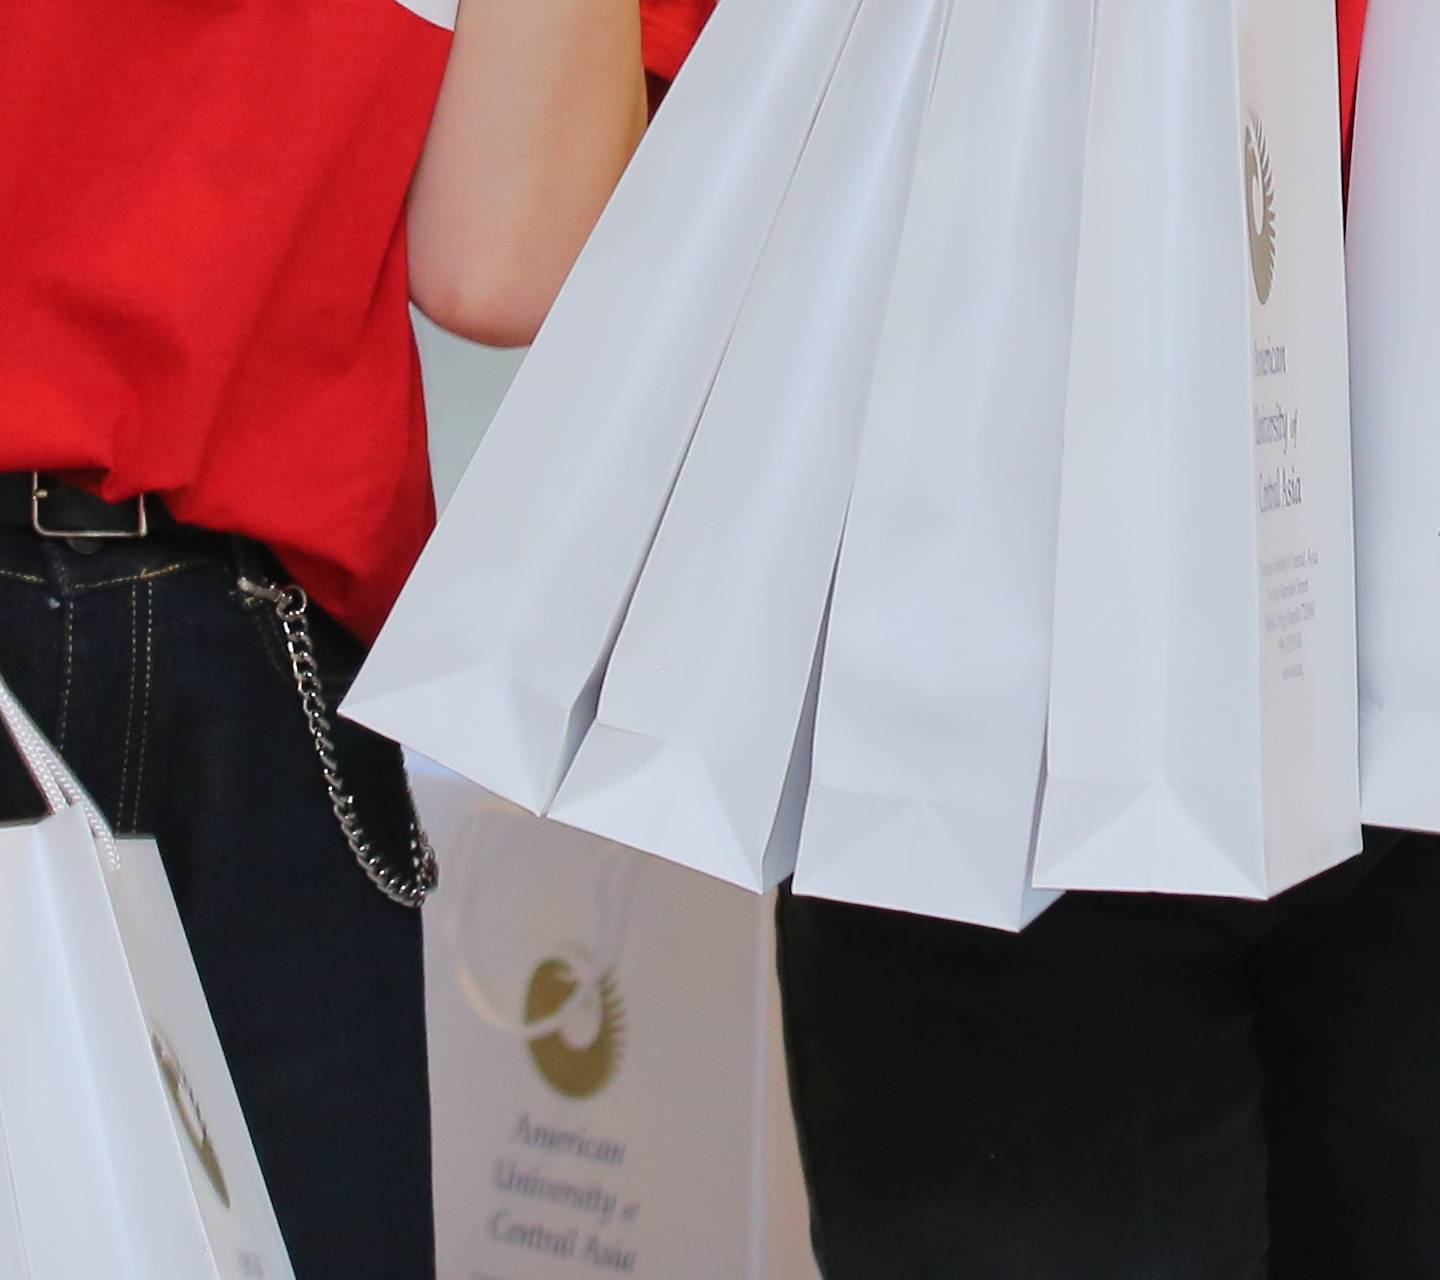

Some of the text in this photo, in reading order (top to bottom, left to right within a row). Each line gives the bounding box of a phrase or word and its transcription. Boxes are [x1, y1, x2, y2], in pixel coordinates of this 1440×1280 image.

[516, 1111, 626, 1168] American
[491, 1157, 618, 1225] University
[486, 1207, 636, 1275] Central Asia
